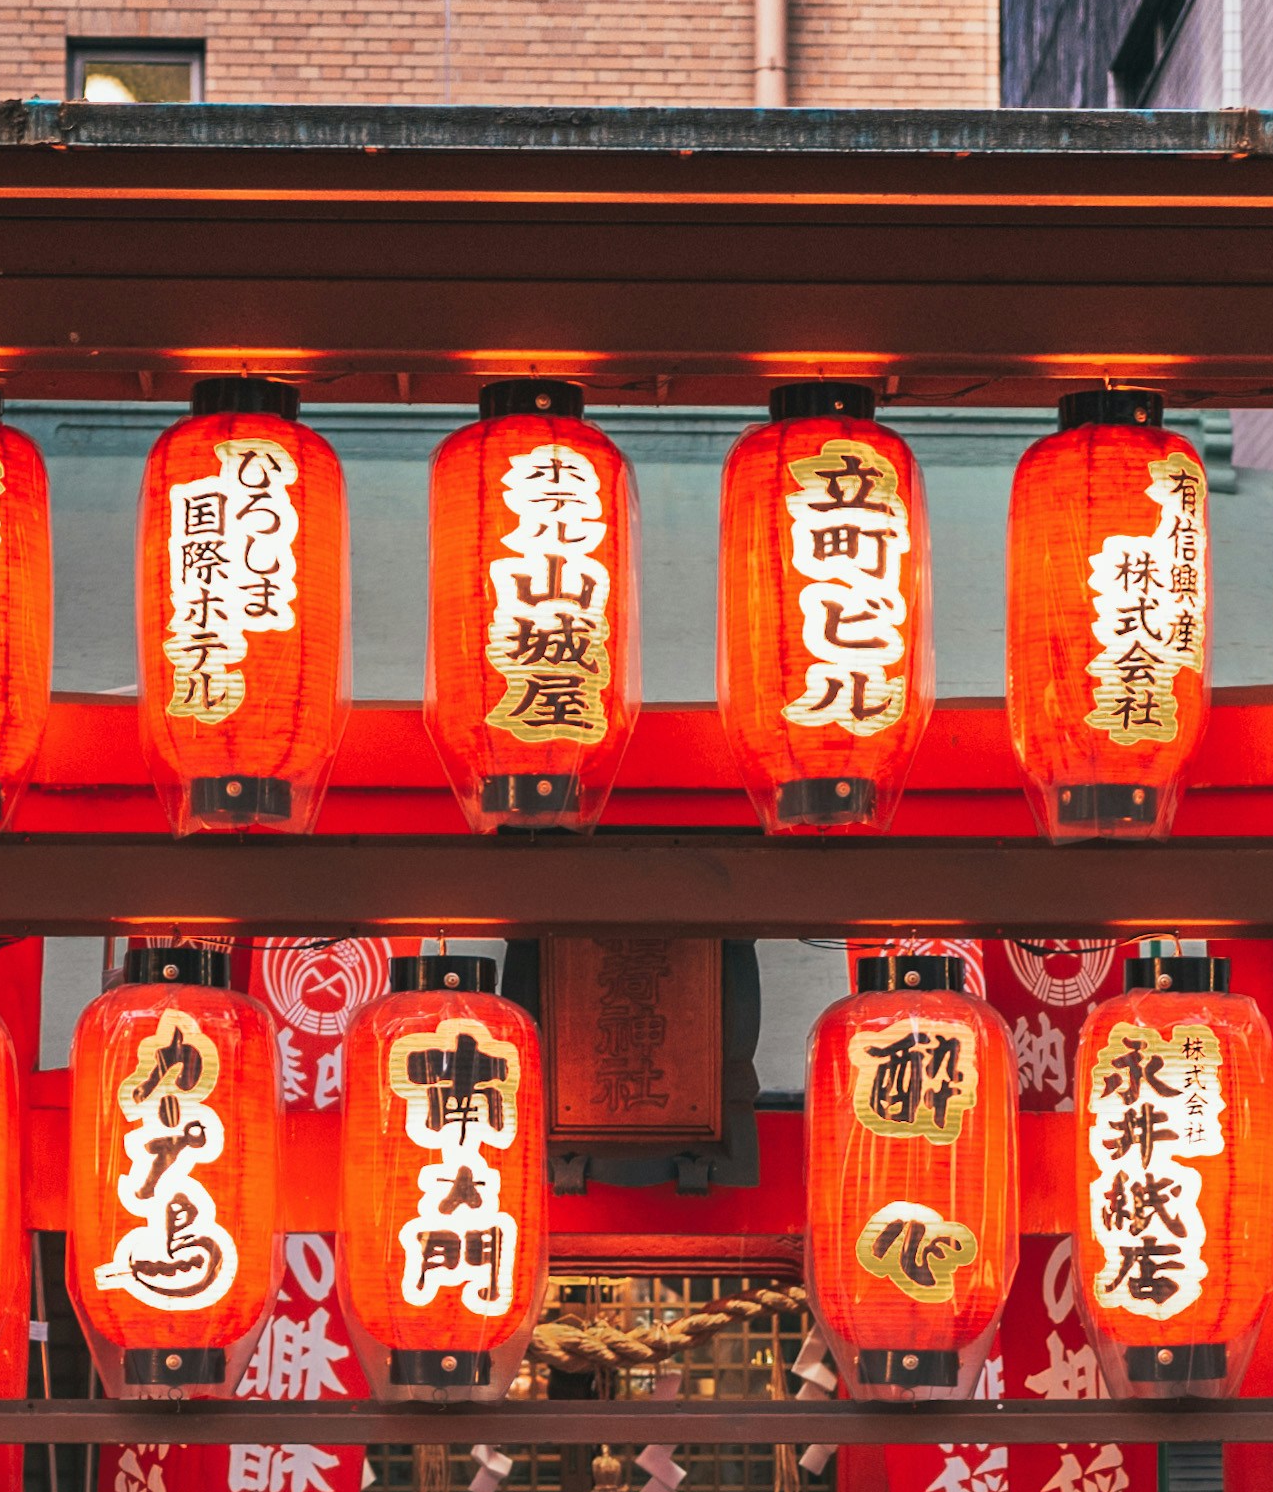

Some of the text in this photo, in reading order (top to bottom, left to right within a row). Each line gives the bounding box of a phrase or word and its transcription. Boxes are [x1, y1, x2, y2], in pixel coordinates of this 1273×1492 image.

[181, 491, 230, 711] 国際ホテル
[234, 448, 284, 620] ひろしま
[807, 453, 898, 722] 立町ビル
[1112, 551, 1164, 730] 株式会社
[1180, 1036, 1209, 1146] 株式会社
